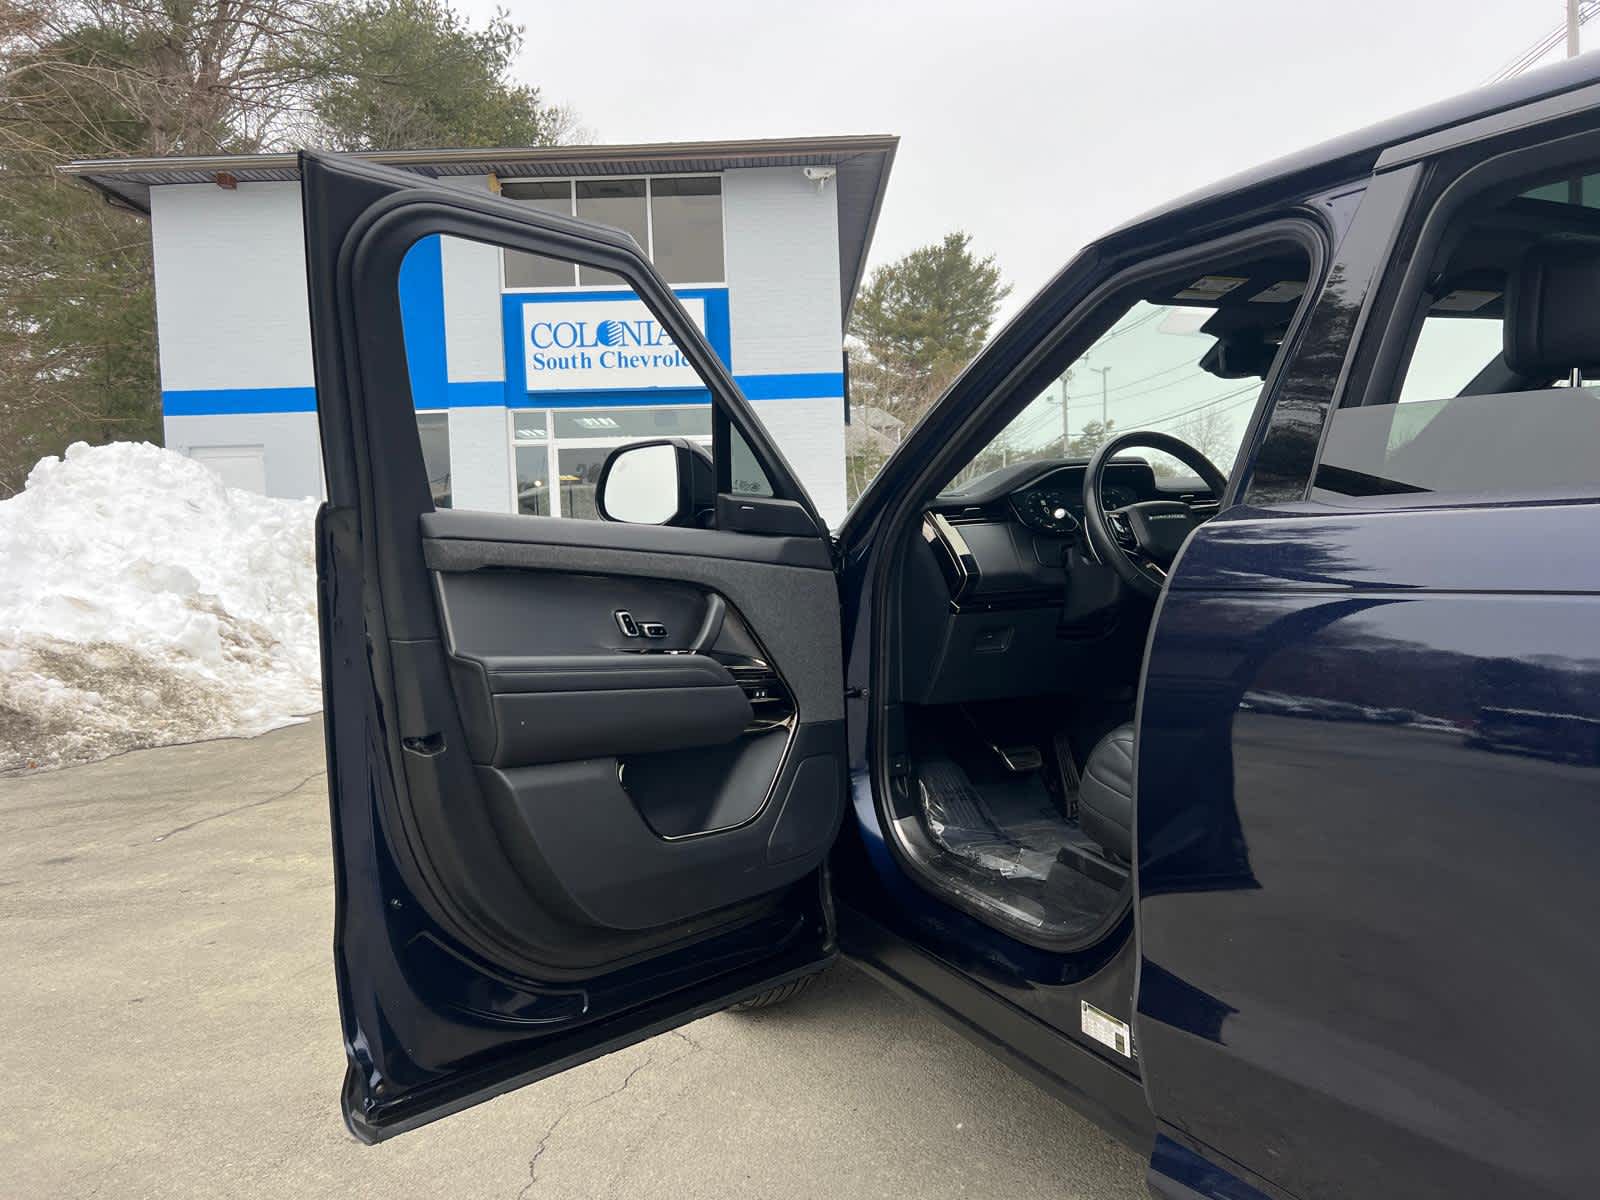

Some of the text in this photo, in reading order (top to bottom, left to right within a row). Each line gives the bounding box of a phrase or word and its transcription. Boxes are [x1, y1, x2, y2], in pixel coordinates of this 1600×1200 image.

[530, 319, 680, 349] COLONIA
[533, 350, 690, 371] South Chevrole
